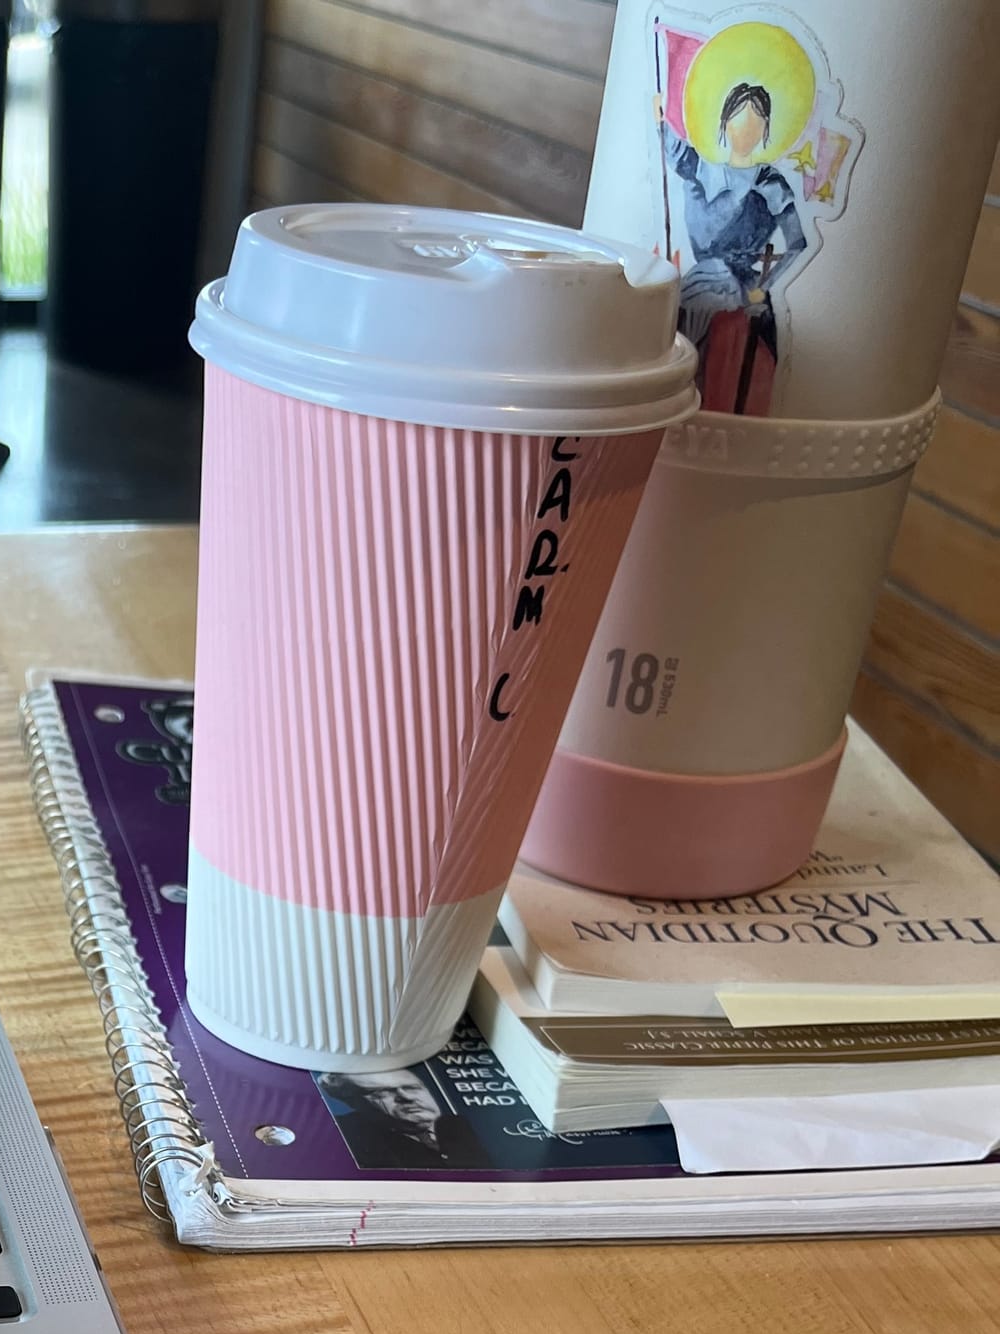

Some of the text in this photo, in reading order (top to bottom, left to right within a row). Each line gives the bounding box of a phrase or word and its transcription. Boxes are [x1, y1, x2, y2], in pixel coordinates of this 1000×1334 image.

[606, 647, 660, 716] 18
[570, 914, 1000, 949] THE QUOTIDIAN
[623, 1041, 703, 1051] CLASSIC
[706, 1040, 774, 1050] PIEPER
[776, 1039, 827, 1050] THIS
[830, 1038, 856, 1047] OF
[437, 1054, 494, 1066] WAS
[446, 1067, 493, 1079] SHE
[462, 1095, 517, 1107] HAD
